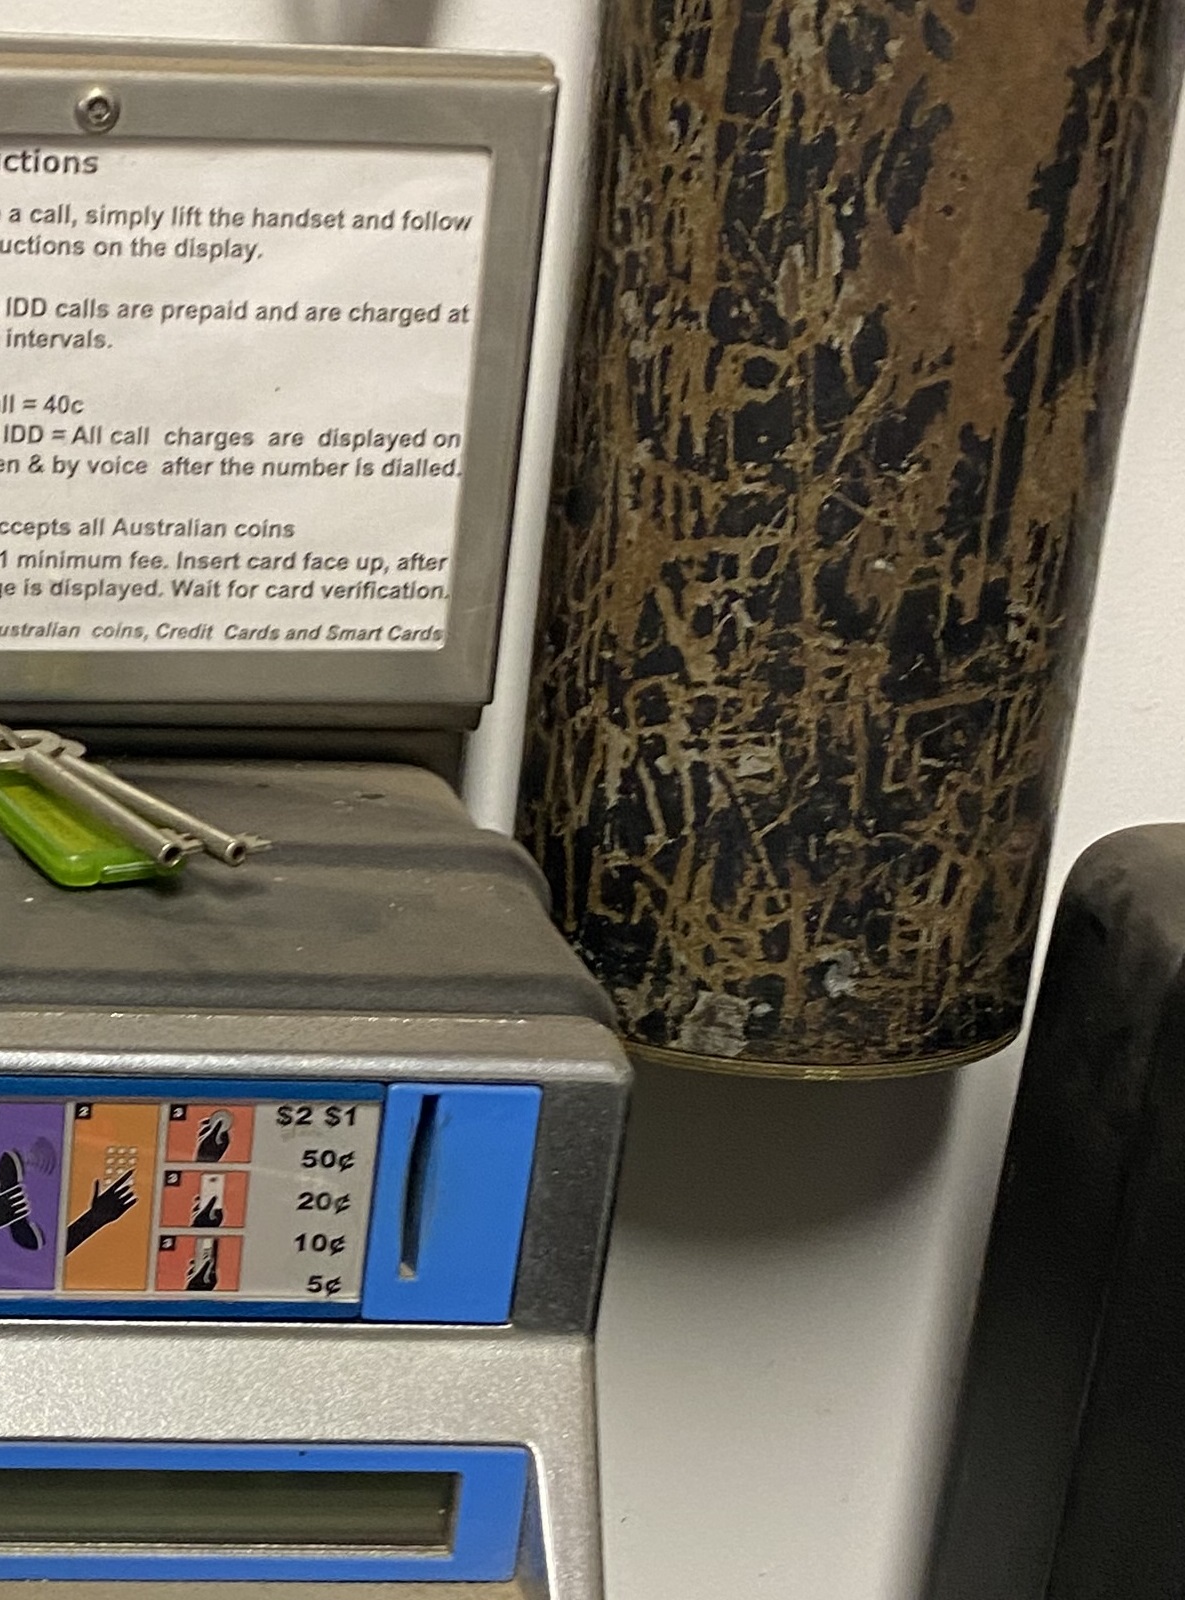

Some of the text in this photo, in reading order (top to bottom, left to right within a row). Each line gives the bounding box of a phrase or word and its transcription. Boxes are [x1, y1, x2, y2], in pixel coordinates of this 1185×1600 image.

[8, 208, 22, 224] a
[29, 203, 77, 229] call,
[85, 204, 165, 233] simply
[171, 205, 203, 228] lift
[208, 206, 246, 228] the
[251, 207, 345, 230] handset
[351, 209, 396, 231] and
[401, 205, 474, 231] follow
[93, 240, 123, 258] on
[129, 236, 168, 258] the
[174, 236, 263, 264] display.
[5, 296, 48, 318] IDD
[55, 297, 110, 320] calls
[117, 303, 154, 320] are
[160, 299, 248, 326] prepaid
[255, 300, 299, 323] and
[304, 306, 342, 322] are
[348, 301, 442, 328] charged
[447, 304, 470, 324] at
[6, 327, 113, 349] intervals.
[42, 394, 85, 415] 40c
[3, 423, 45, 445] IDD
[70, 424, 103, 446] All
[108, 426, 150, 447] call
[164, 426, 255, 453] charges
[267, 432, 305, 448] are
[317, 427, 427, 454] displayed
[432, 431, 460, 449] on
[27, 453, 45, 474] &
[52, 454, 81, 480] by
[86, 455, 149, 476] voice
[161, 455, 215, 476] after
[219, 456, 256, 476] the
[261, 457, 350, 478] number
[354, 457, 375, 477] is
[381, 456, 463, 478] dialled.
[78, 517, 105, 537] all
[111, 517, 227, 538] Australian
[234, 519, 295, 539] coins
[16, 549, 122, 571] minimum
[128, 550, 169, 570] fee.
[176, 550, 243, 572] Insert
[245, 551, 297, 572] card
[302, 551, 350, 573] face
[355, 556, 390, 576] up,
[396, 552, 448, 574] after
[23, 578, 44, 597] is
[49, 578, 165, 602] displayed.
[170, 579, 221, 600] Wait
[226, 579, 260, 599] for
[265, 580, 315, 600] card
[320, 580, 452, 601] verification.
[91, 621, 149, 642] coins,
[155, 622, 214, 641] Credit
[224, 624, 280, 641] Cards
[284, 624, 323, 641] and
[325, 624, 384, 641] Smart
[387, 624, 444, 643] Cards
[275, 1105, 357, 1128] $2 $1
[302, 1150, 356, 1172] 50¢
[296, 1191, 351, 1214] 20¢
[294, 1233, 346, 1255] 10¢
[306, 1275, 341, 1296] 5¢
